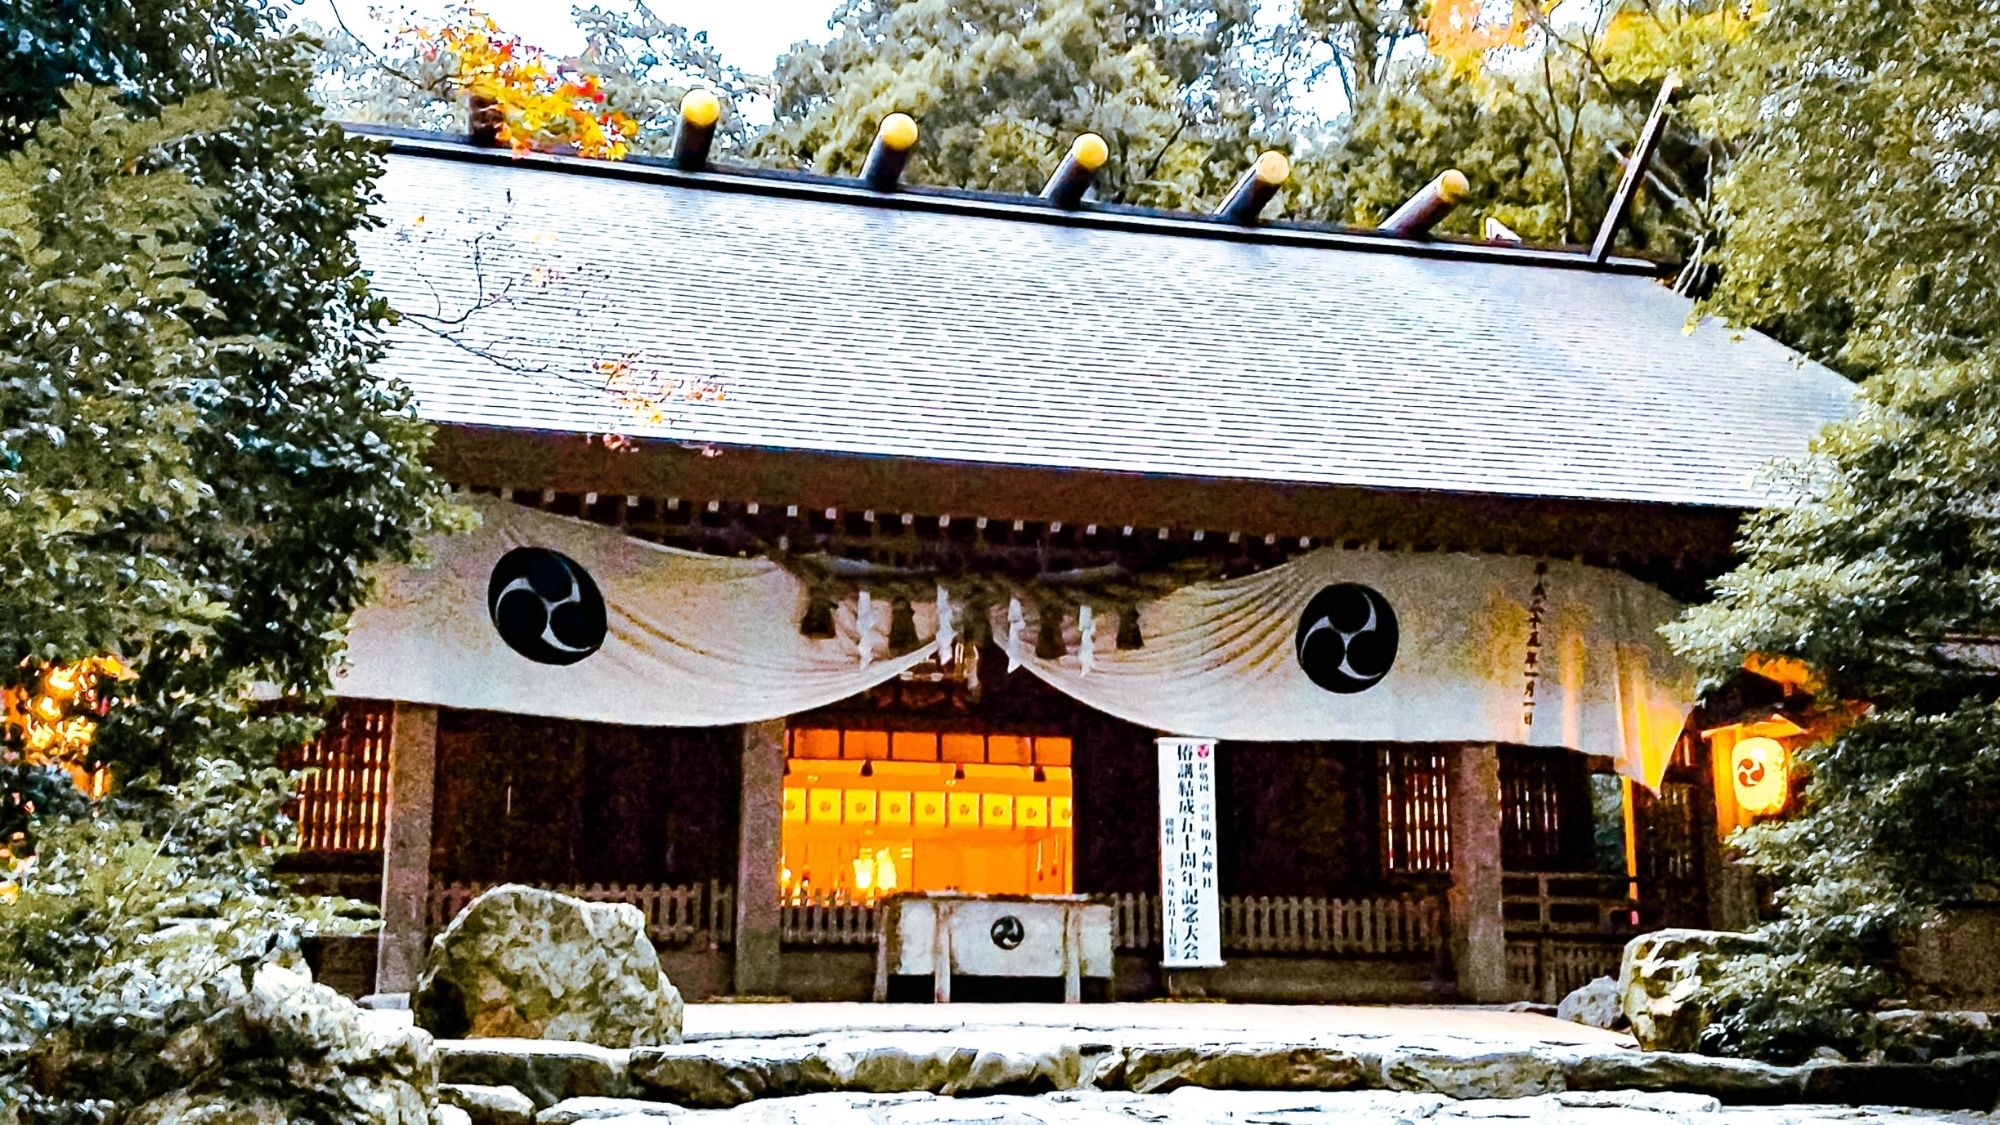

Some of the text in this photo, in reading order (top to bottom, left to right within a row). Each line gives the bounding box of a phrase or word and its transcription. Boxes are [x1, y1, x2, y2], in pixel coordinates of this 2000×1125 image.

[1177, 744, 1199, 960] 椿講結成五十周年記念大会
[1199, 762, 1210, 822] 伊勢国の宮
